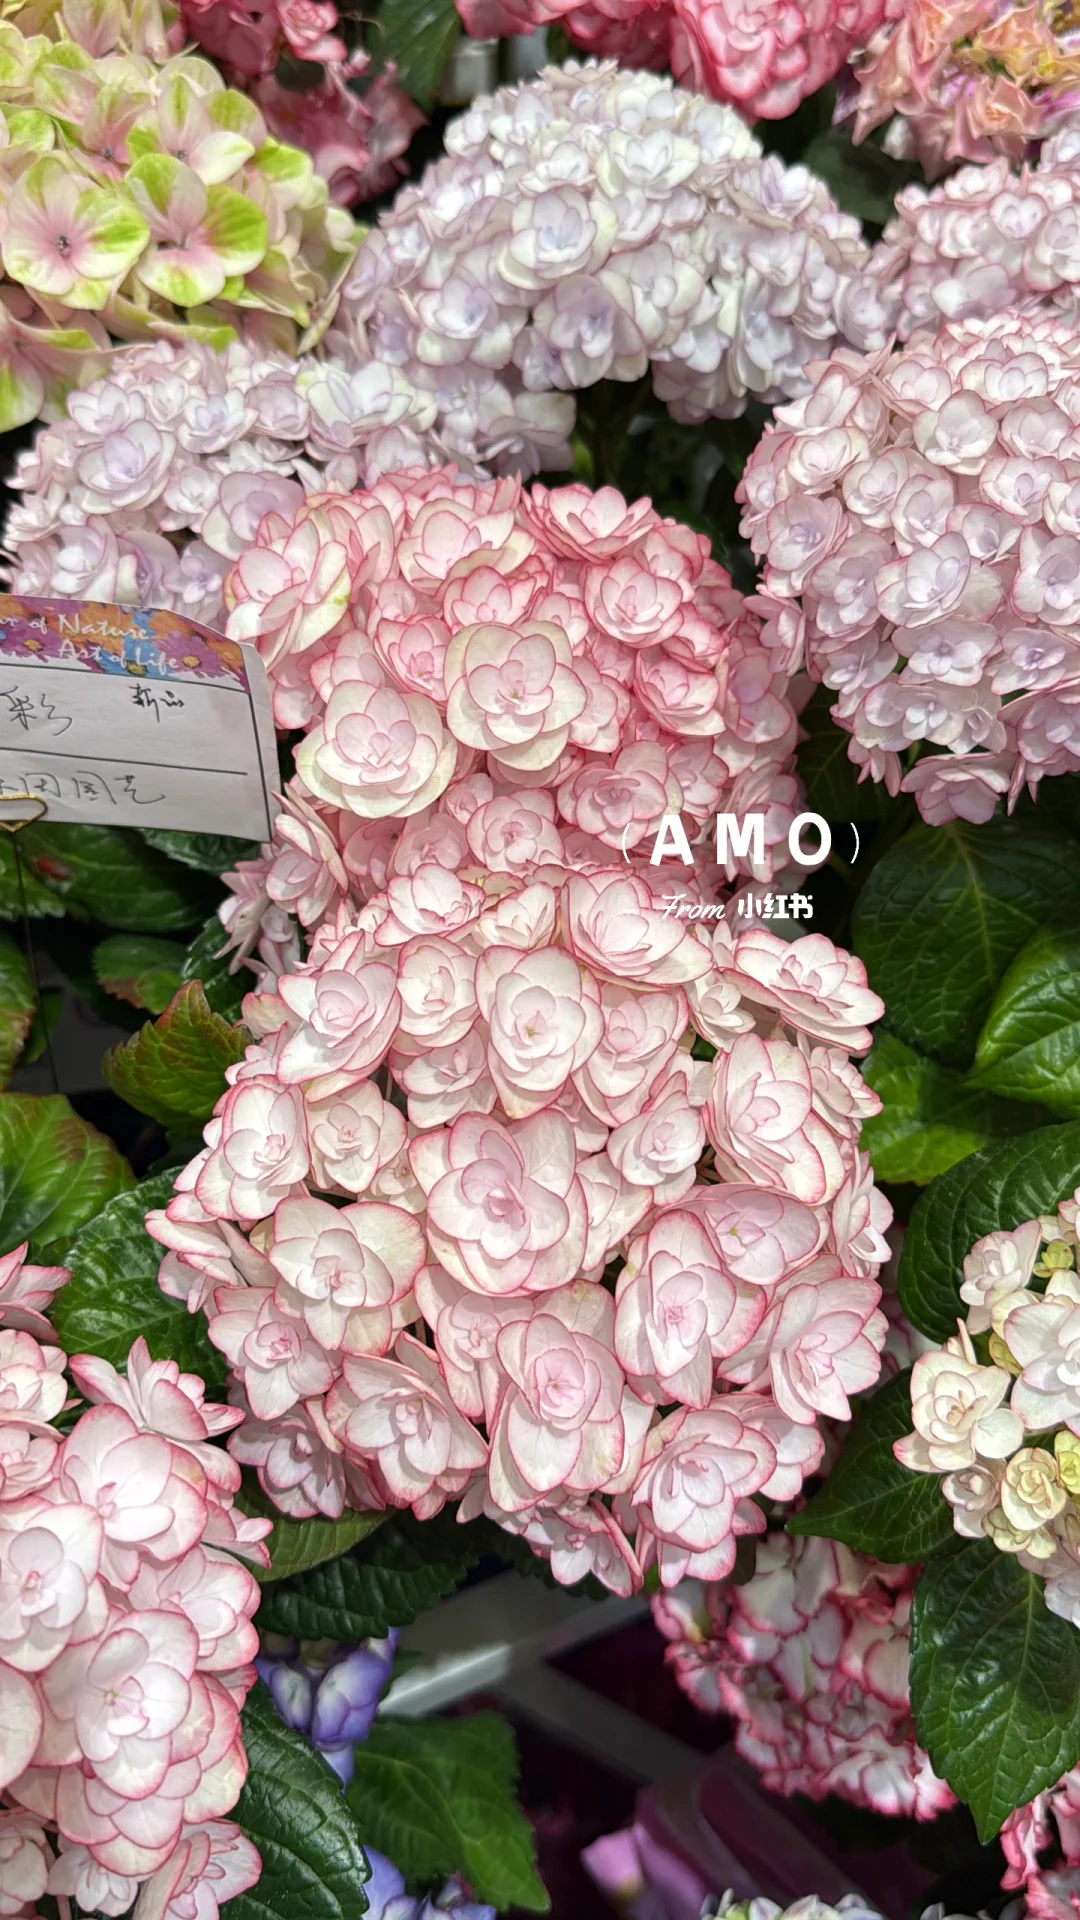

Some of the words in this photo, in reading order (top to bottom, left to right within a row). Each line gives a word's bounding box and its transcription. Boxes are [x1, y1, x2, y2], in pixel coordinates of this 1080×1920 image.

[28, 616, 48, 635] of
[58, 613, 150, 640] Nature
[58, 639, 103, 661] Art
[110, 653, 127, 669] of
[135, 652, 178, 676] Life
